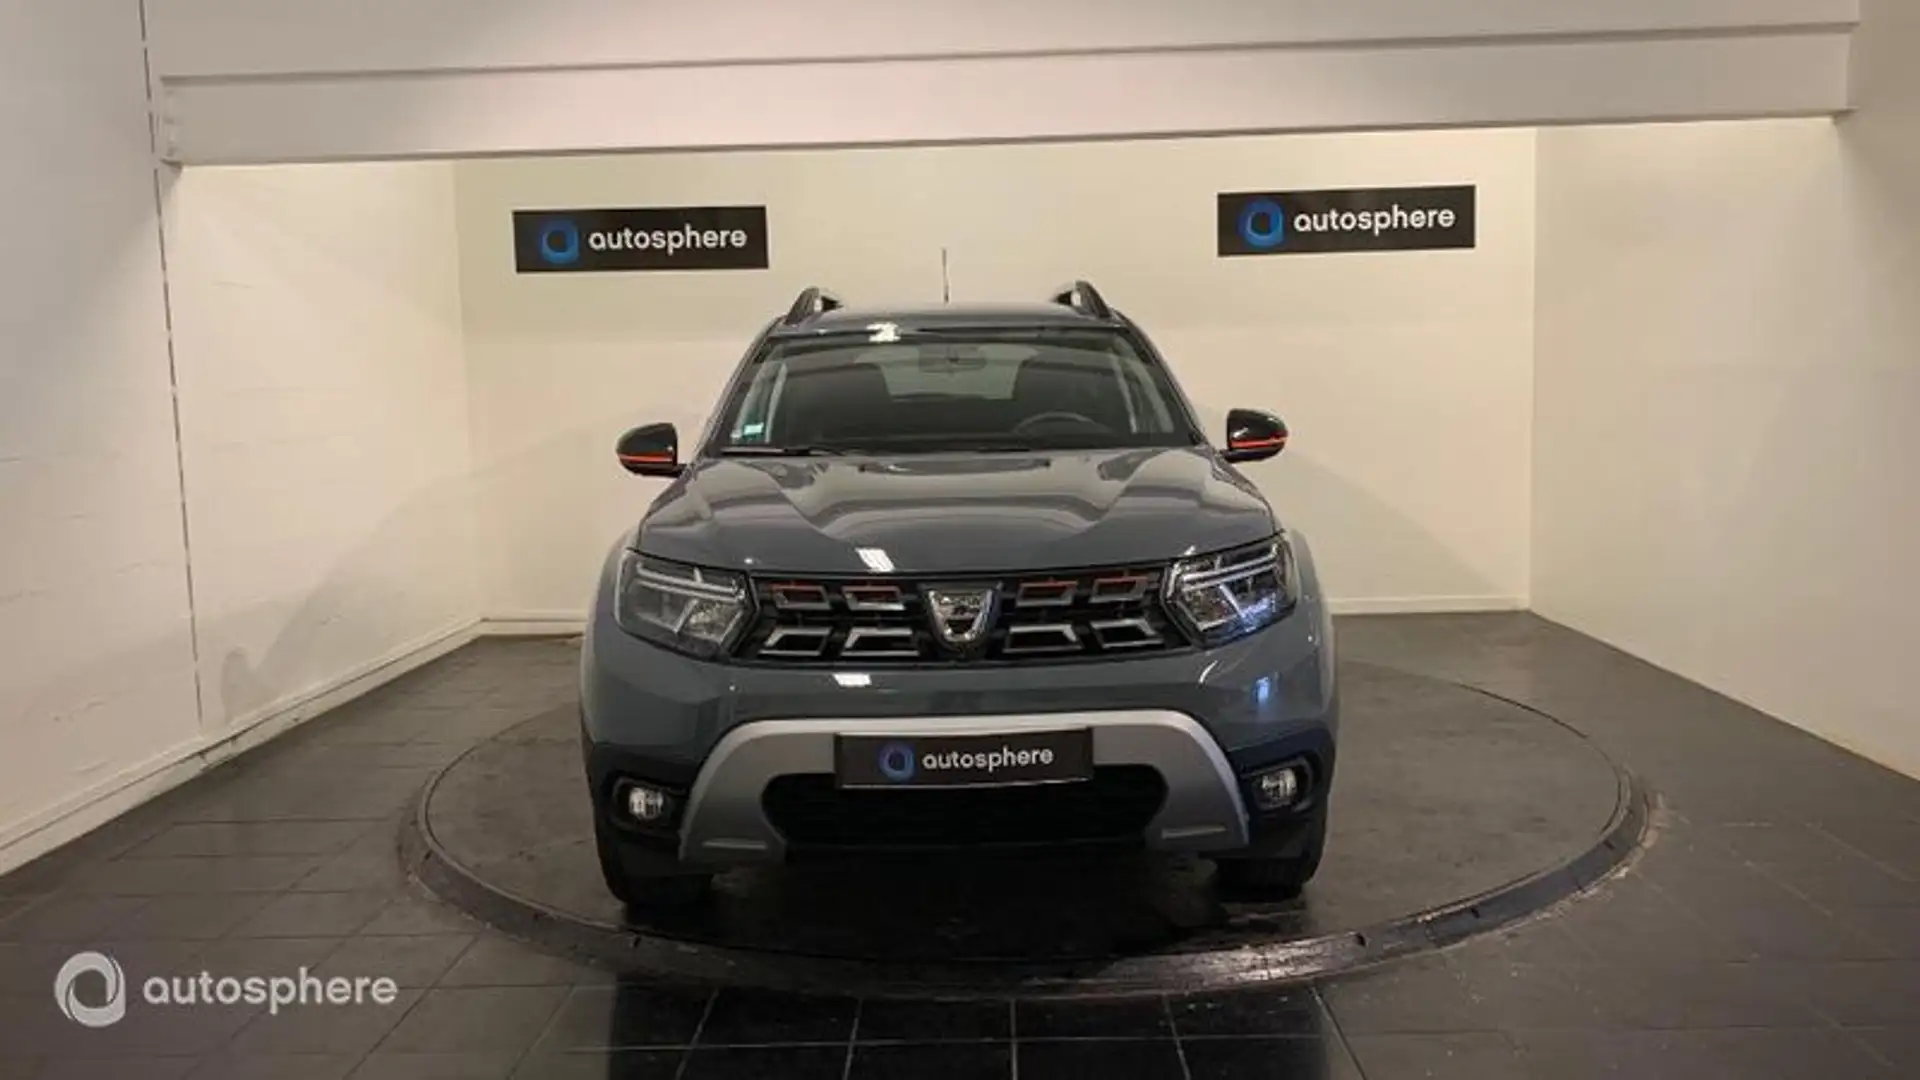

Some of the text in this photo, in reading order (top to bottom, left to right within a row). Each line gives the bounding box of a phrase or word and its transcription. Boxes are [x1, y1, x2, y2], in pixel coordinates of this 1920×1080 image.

[1293, 204, 1455, 236] autosphere
[588, 223, 747, 255] autosphere
[922, 745, 1054, 772] autosphere
